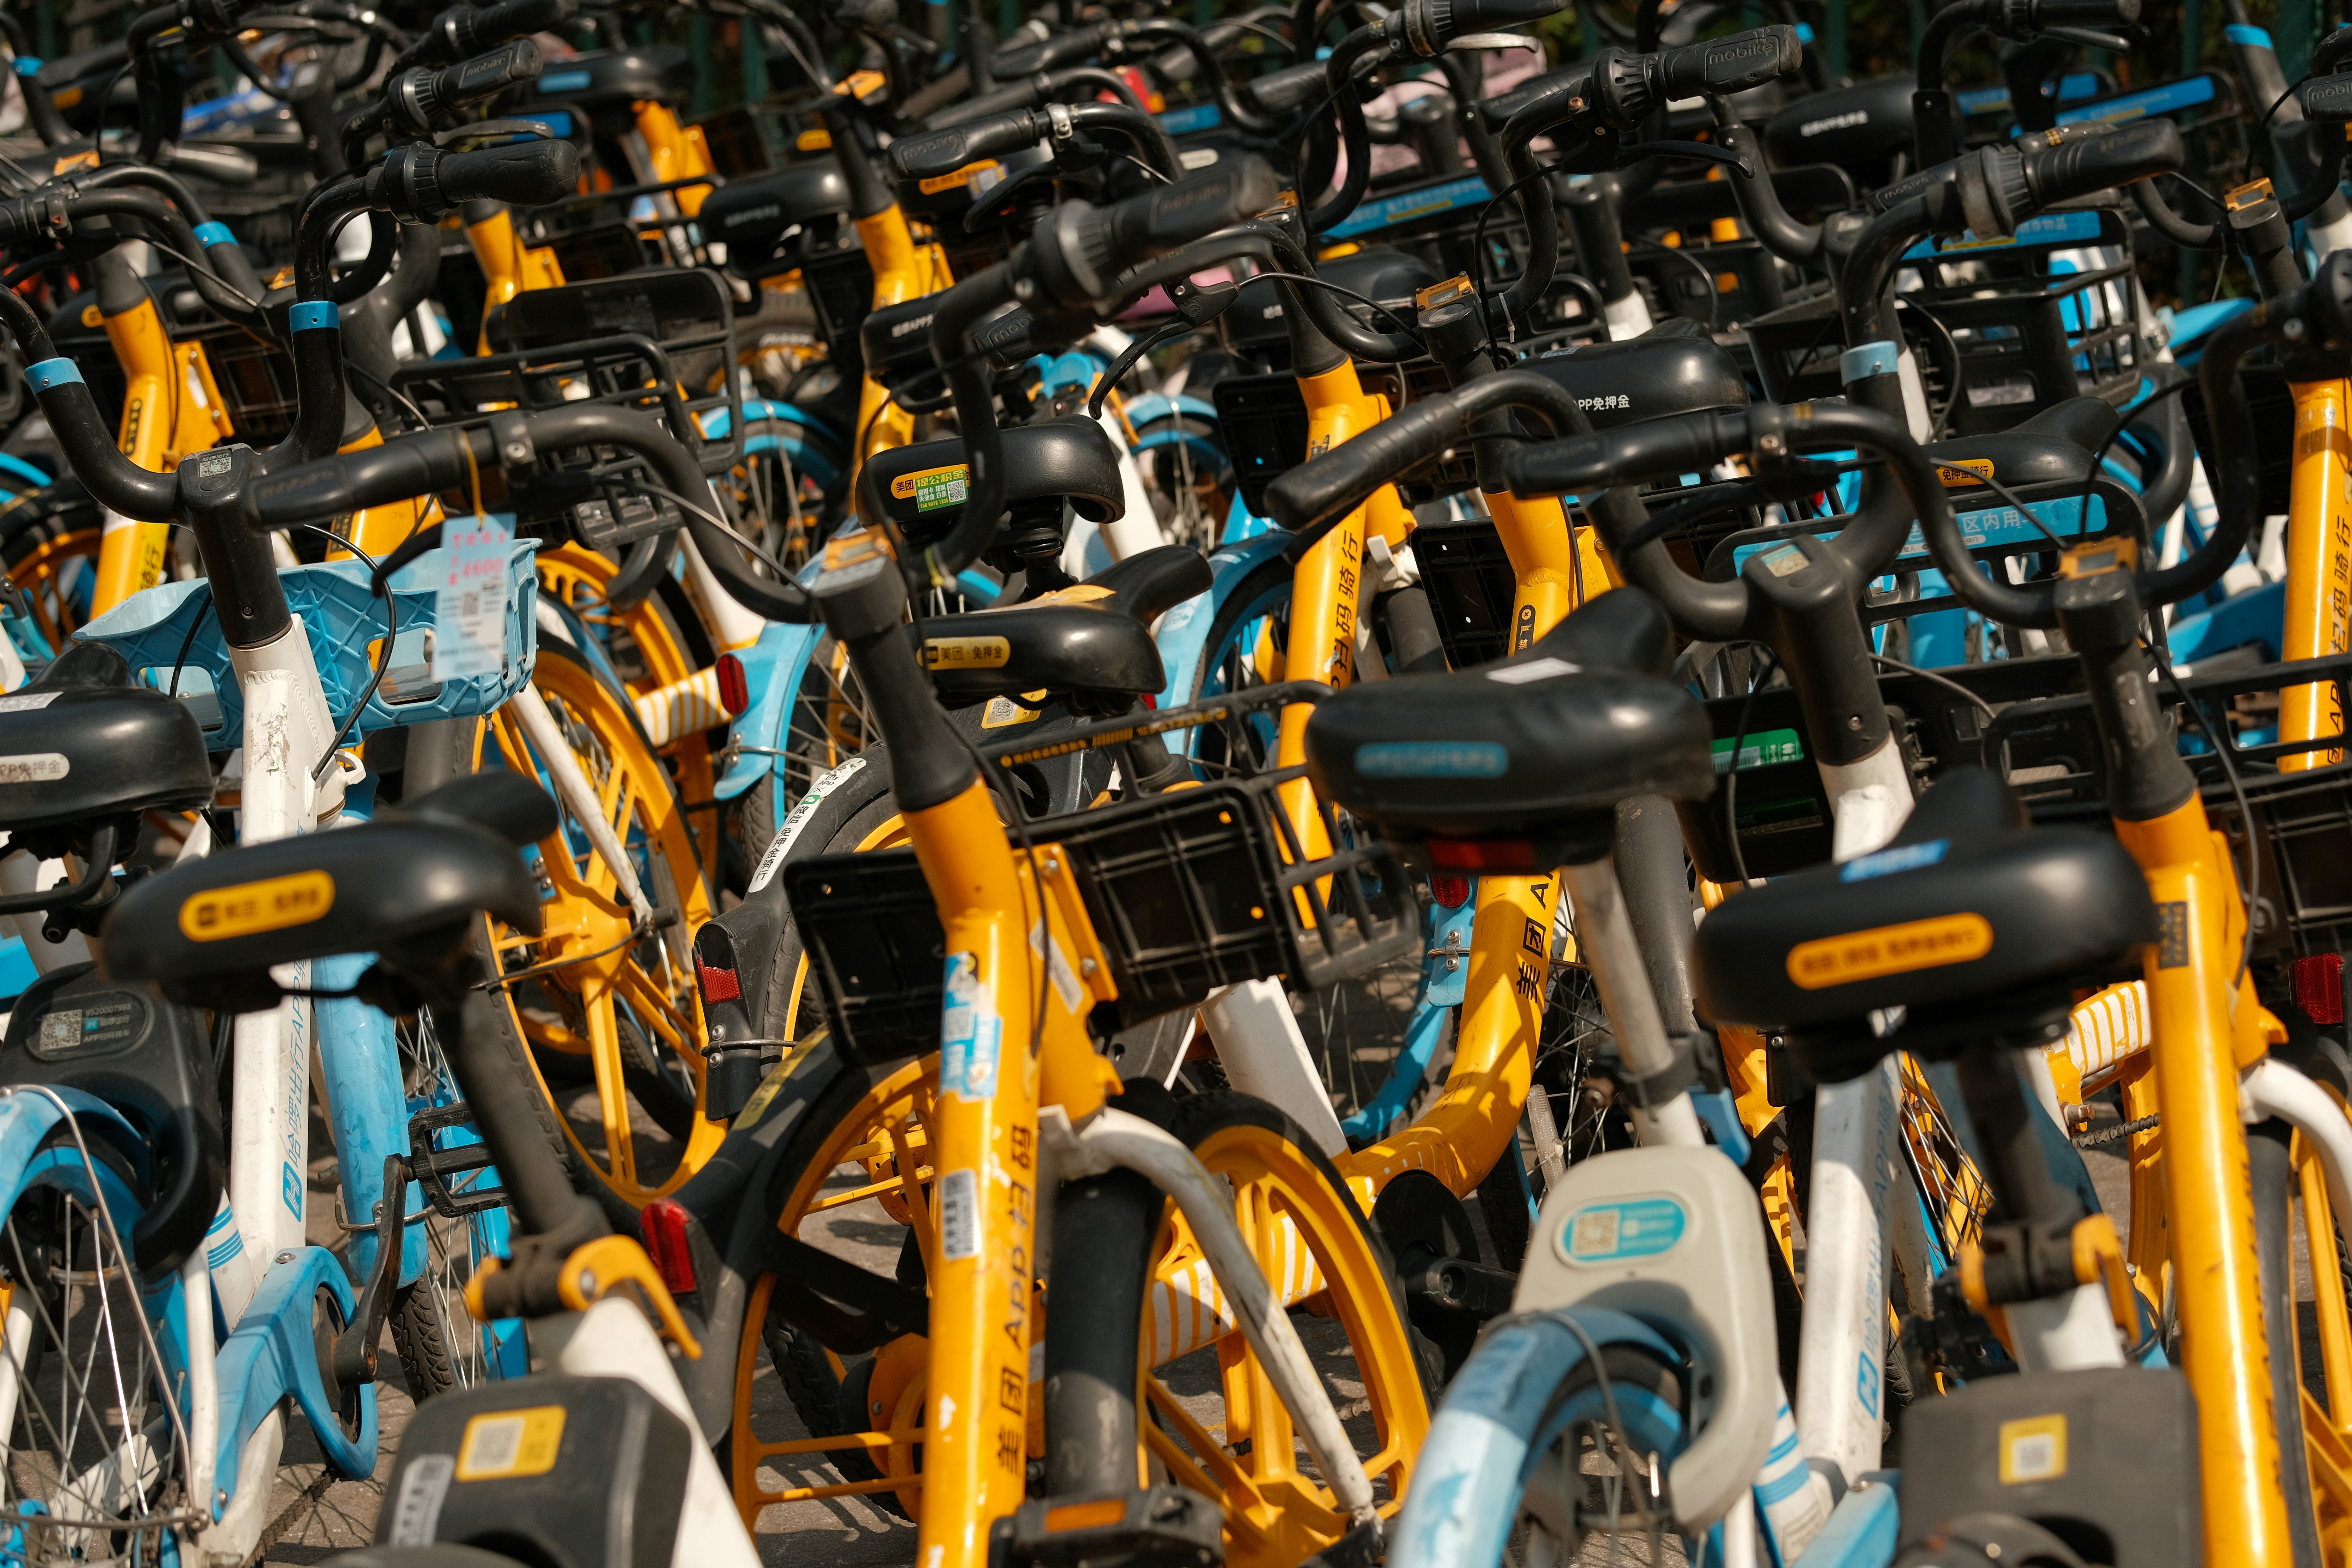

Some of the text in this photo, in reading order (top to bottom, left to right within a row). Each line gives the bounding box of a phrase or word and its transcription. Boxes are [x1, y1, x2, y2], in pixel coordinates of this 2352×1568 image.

[1709, 42, 1774, 64] mobike
[2311, 81, 2352, 101] mobi
[994, 315, 1034, 343] mob
[1574, 394, 1630, 411] PP免押金
[896, 479, 914, 493] 美团
[916, 470, 964, 487] 提公积金
[918, 487, 934, 496] 信用卡
[919, 494, 935, 503] 失业金
[1963, 508, 2038, 533] 区内用
[2331, 514, 2351, 654] 扫码骑行
[1333, 529, 1358, 674] 扫码骑行
[2329, 683, 2342, 733] AP
[787, 805, 809, 825] 微信
[755, 827, 792, 882] 免押金骑行
[1516, 916, 1547, 1004] 美团
